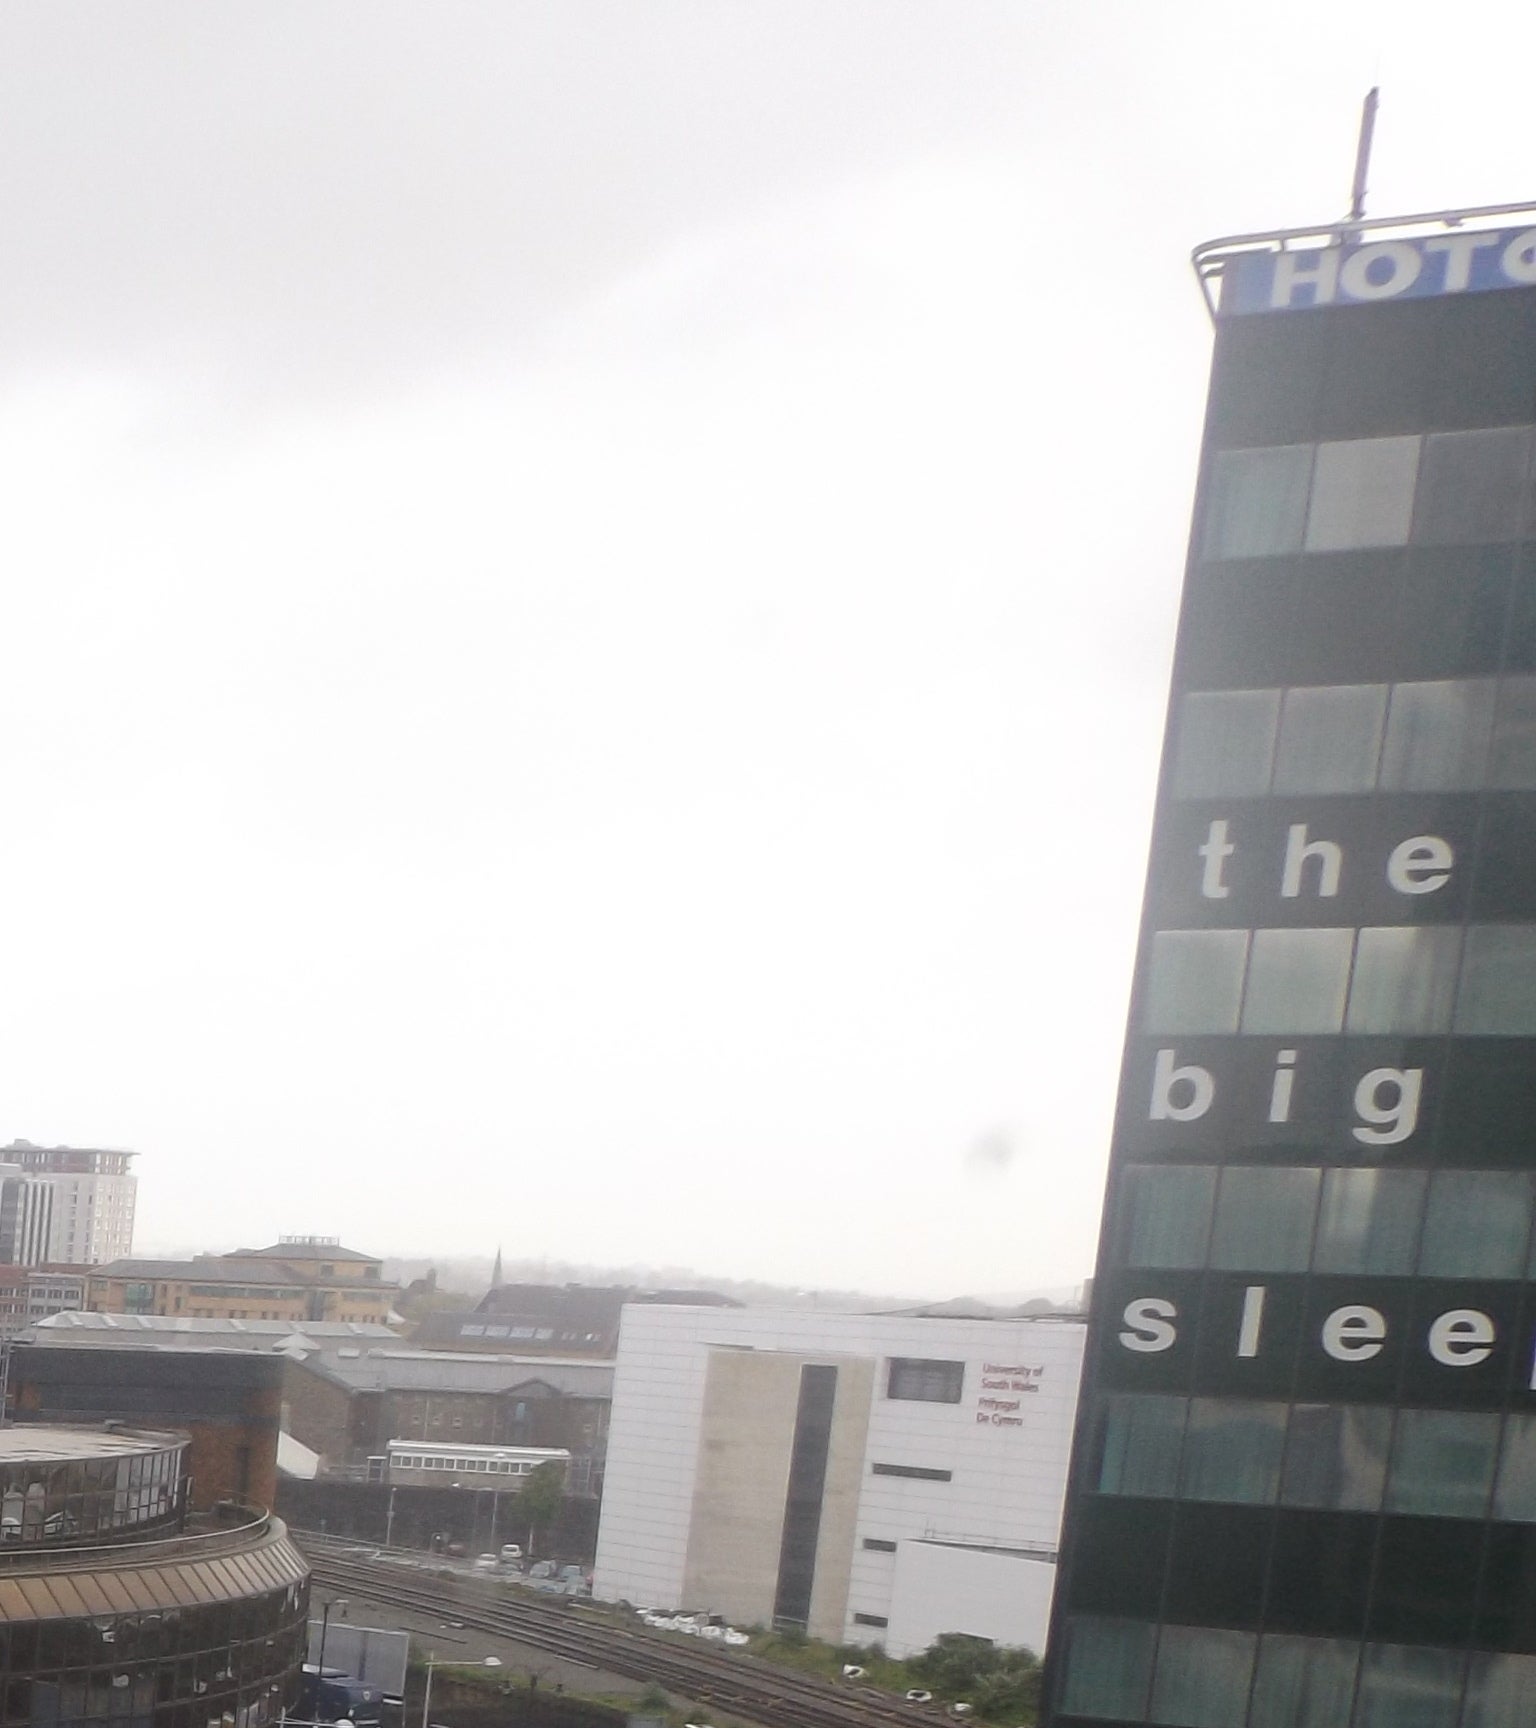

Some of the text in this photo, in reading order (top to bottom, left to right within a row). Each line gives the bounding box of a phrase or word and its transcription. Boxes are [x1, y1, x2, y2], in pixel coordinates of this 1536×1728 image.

[1198, 820, 1454, 898] the
[1149, 1048, 1425, 1145] big
[1119, 1286, 1536, 1391] slee
